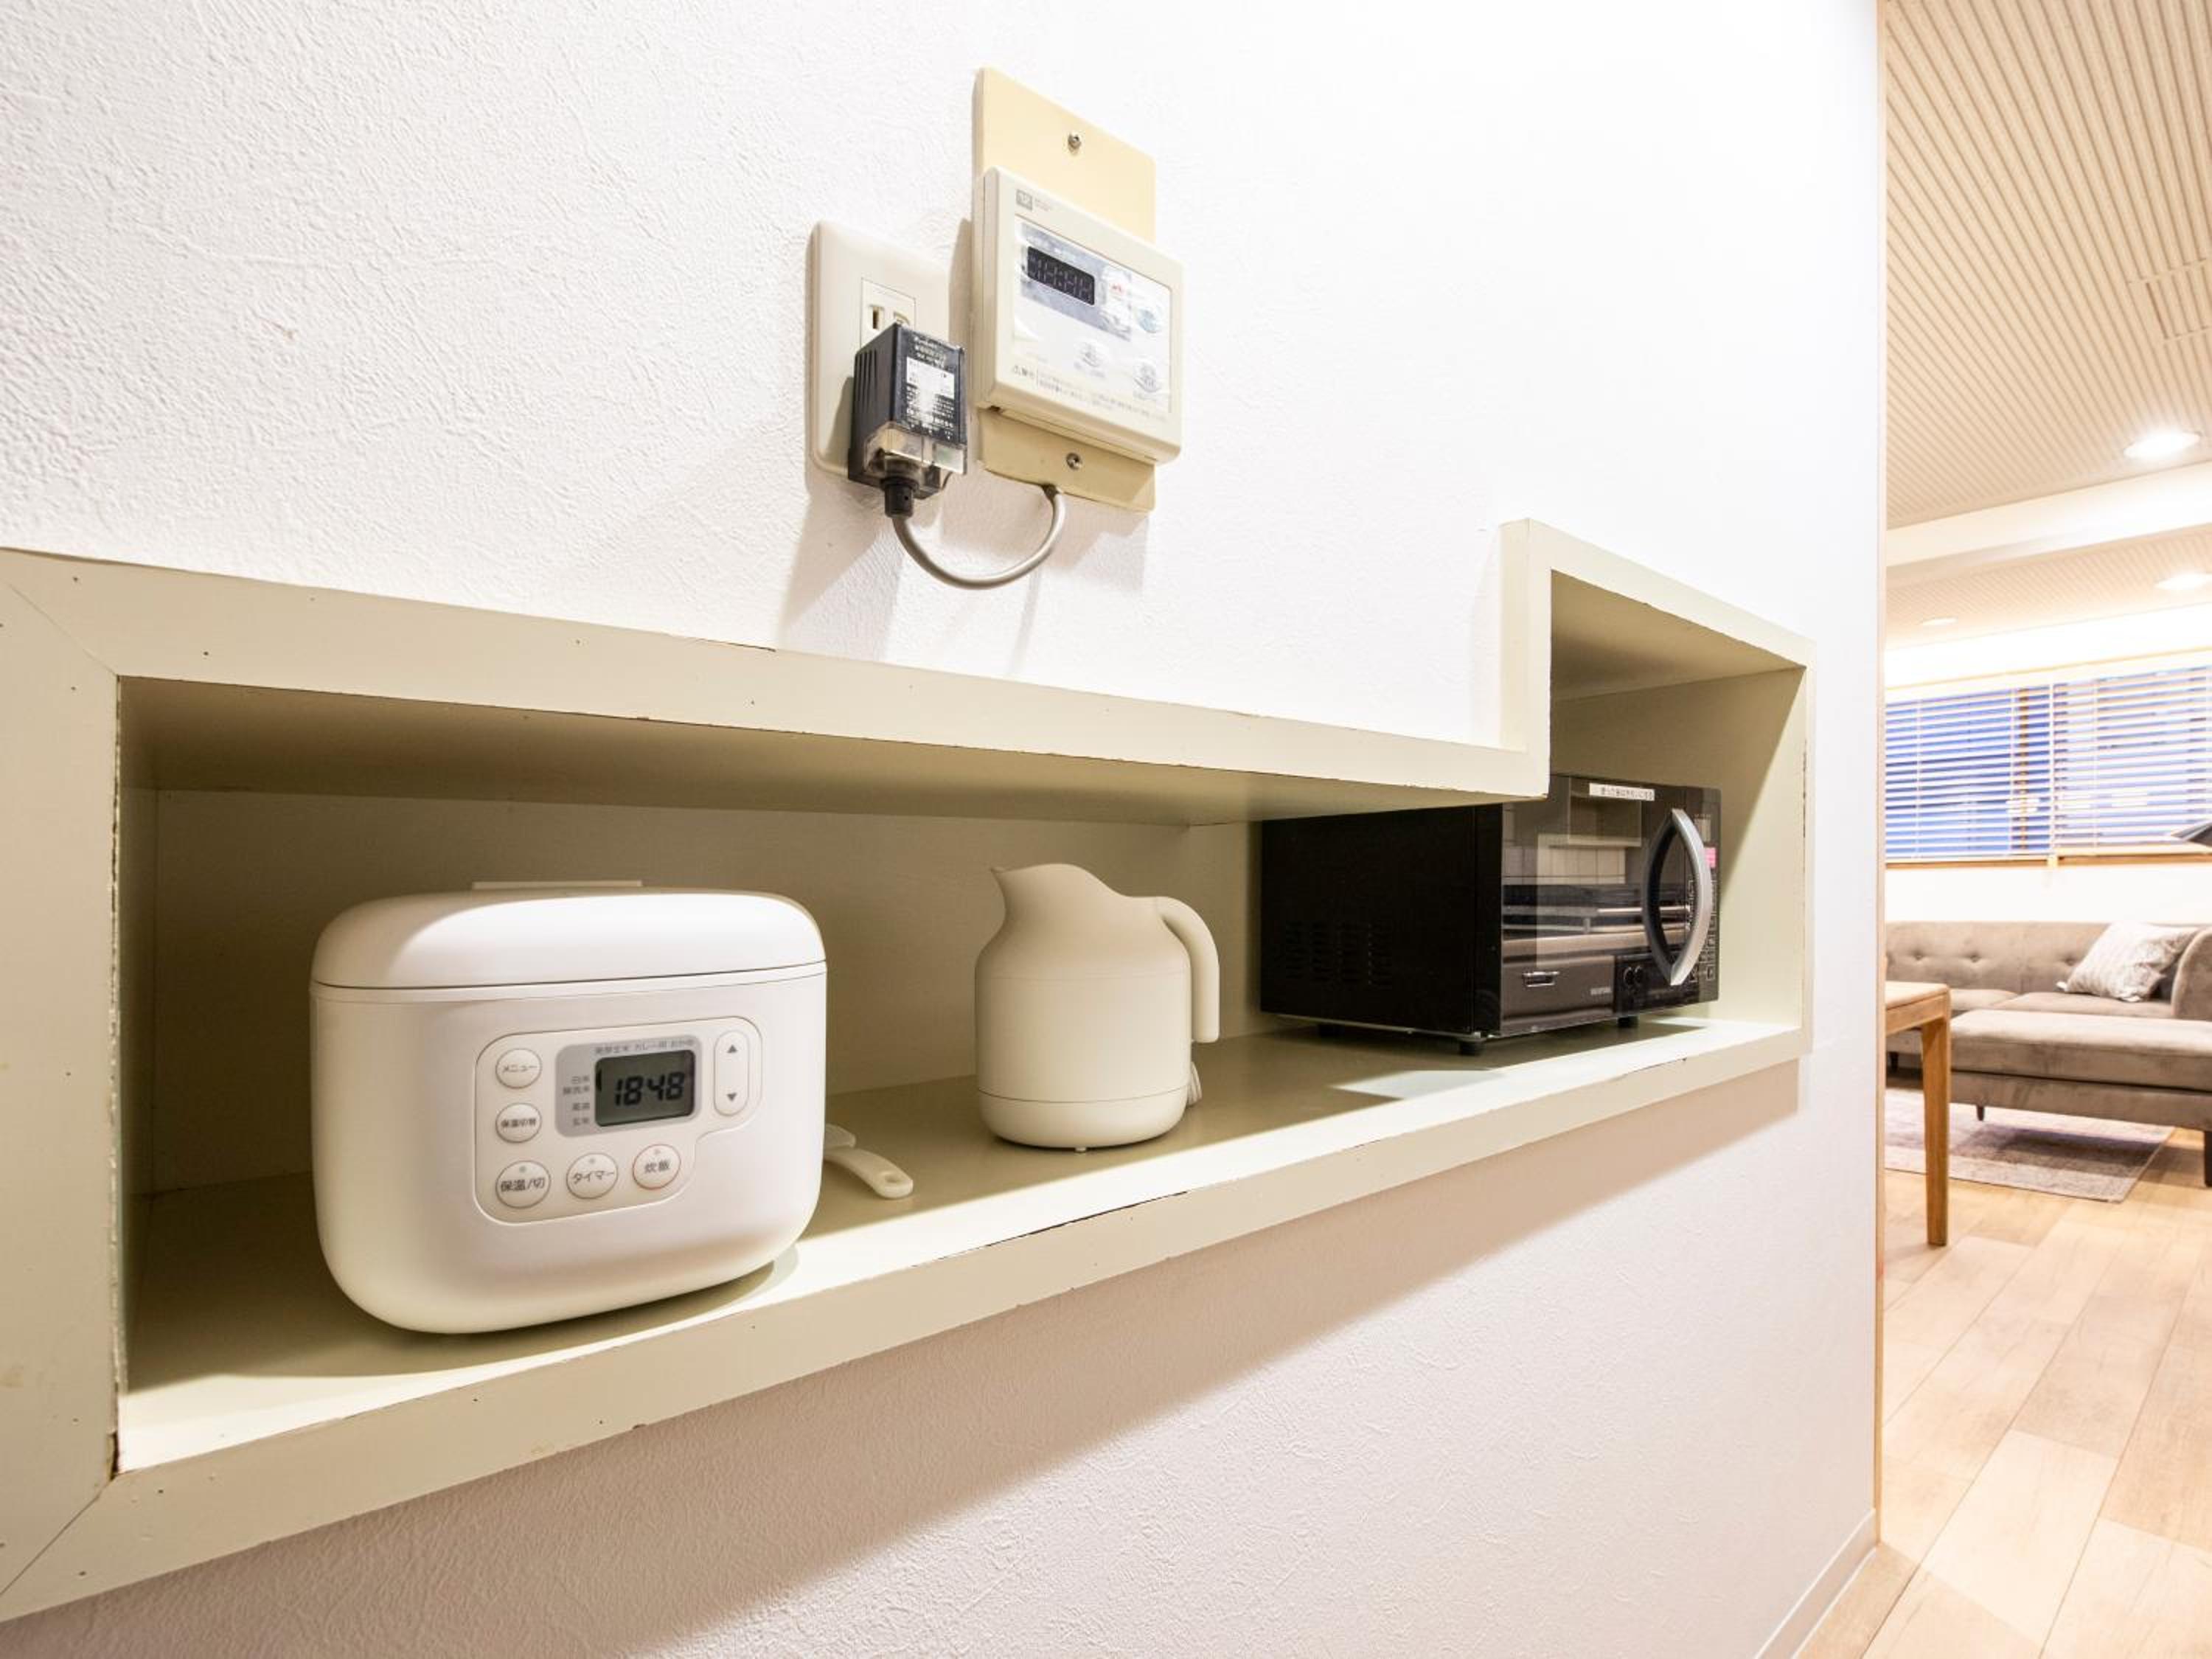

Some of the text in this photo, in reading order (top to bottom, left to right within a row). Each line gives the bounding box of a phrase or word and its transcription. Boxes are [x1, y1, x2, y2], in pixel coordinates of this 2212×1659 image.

[501, 1064, 538, 1074] メニュー
[615, 1071, 685, 1106] 1848
[644, 1161, 670, 1174] 炊飯
[572, 1170, 615, 1184] タイマー
[500, 1177, 546, 1192] 保温/切
